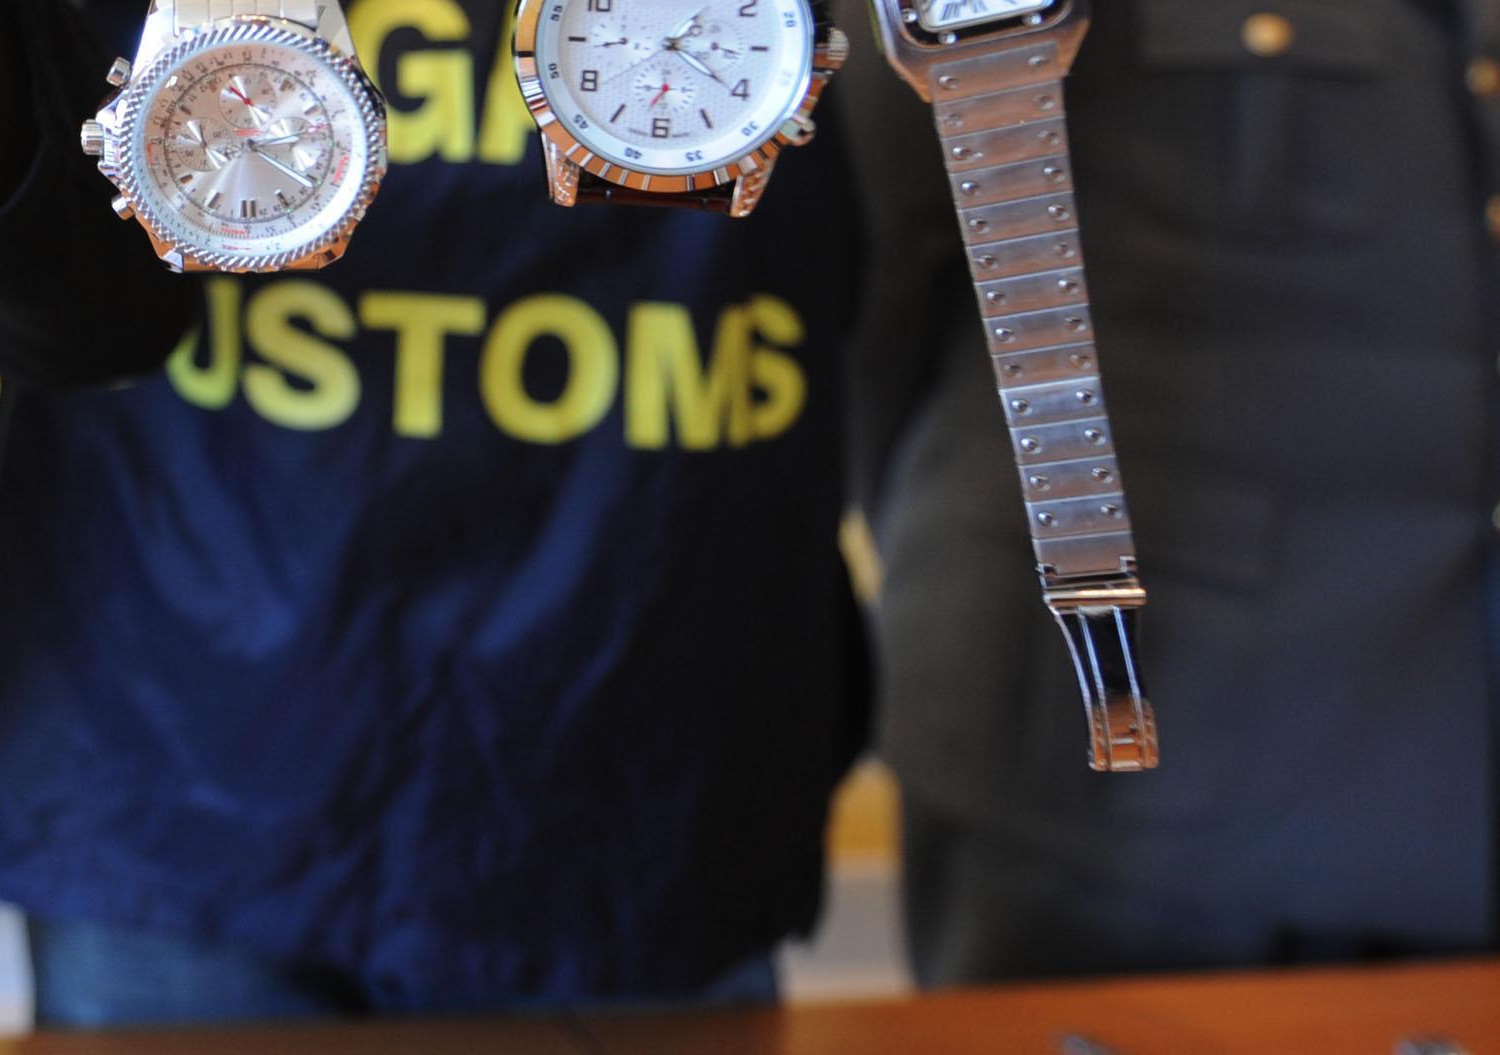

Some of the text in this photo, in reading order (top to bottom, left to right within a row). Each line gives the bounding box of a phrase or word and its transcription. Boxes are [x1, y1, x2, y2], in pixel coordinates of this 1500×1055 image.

[580, 69, 599, 93] 8
[730, 78, 751, 102] 4
[651, 118, 671, 139] 6
